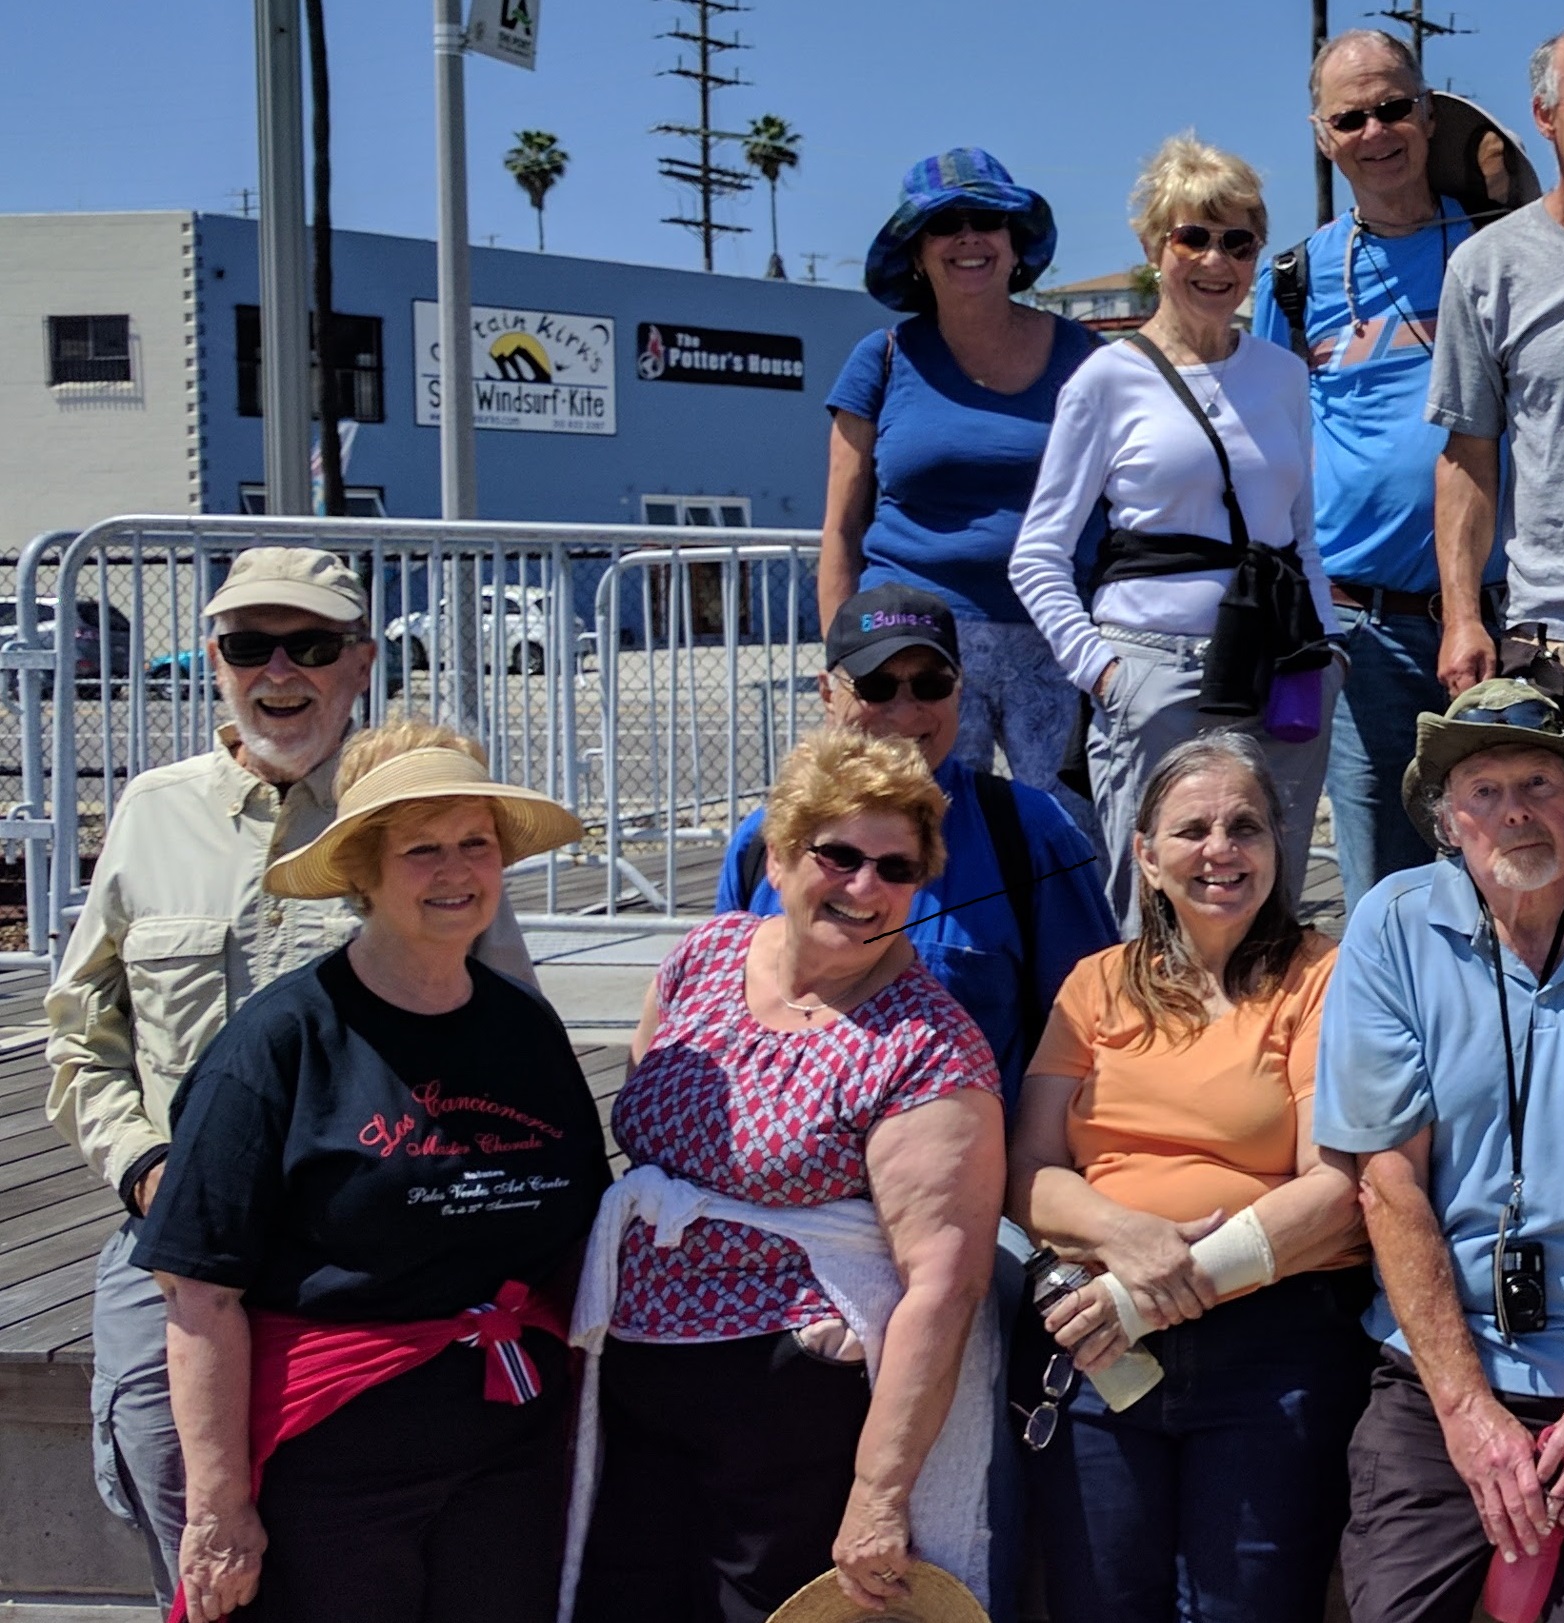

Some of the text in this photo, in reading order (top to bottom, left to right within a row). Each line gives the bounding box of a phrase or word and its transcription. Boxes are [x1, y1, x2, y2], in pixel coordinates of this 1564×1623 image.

[537, 315, 603, 373] Kirk's
[676, 332, 700, 348] The
[669, 347, 803, 378] Potter's House
